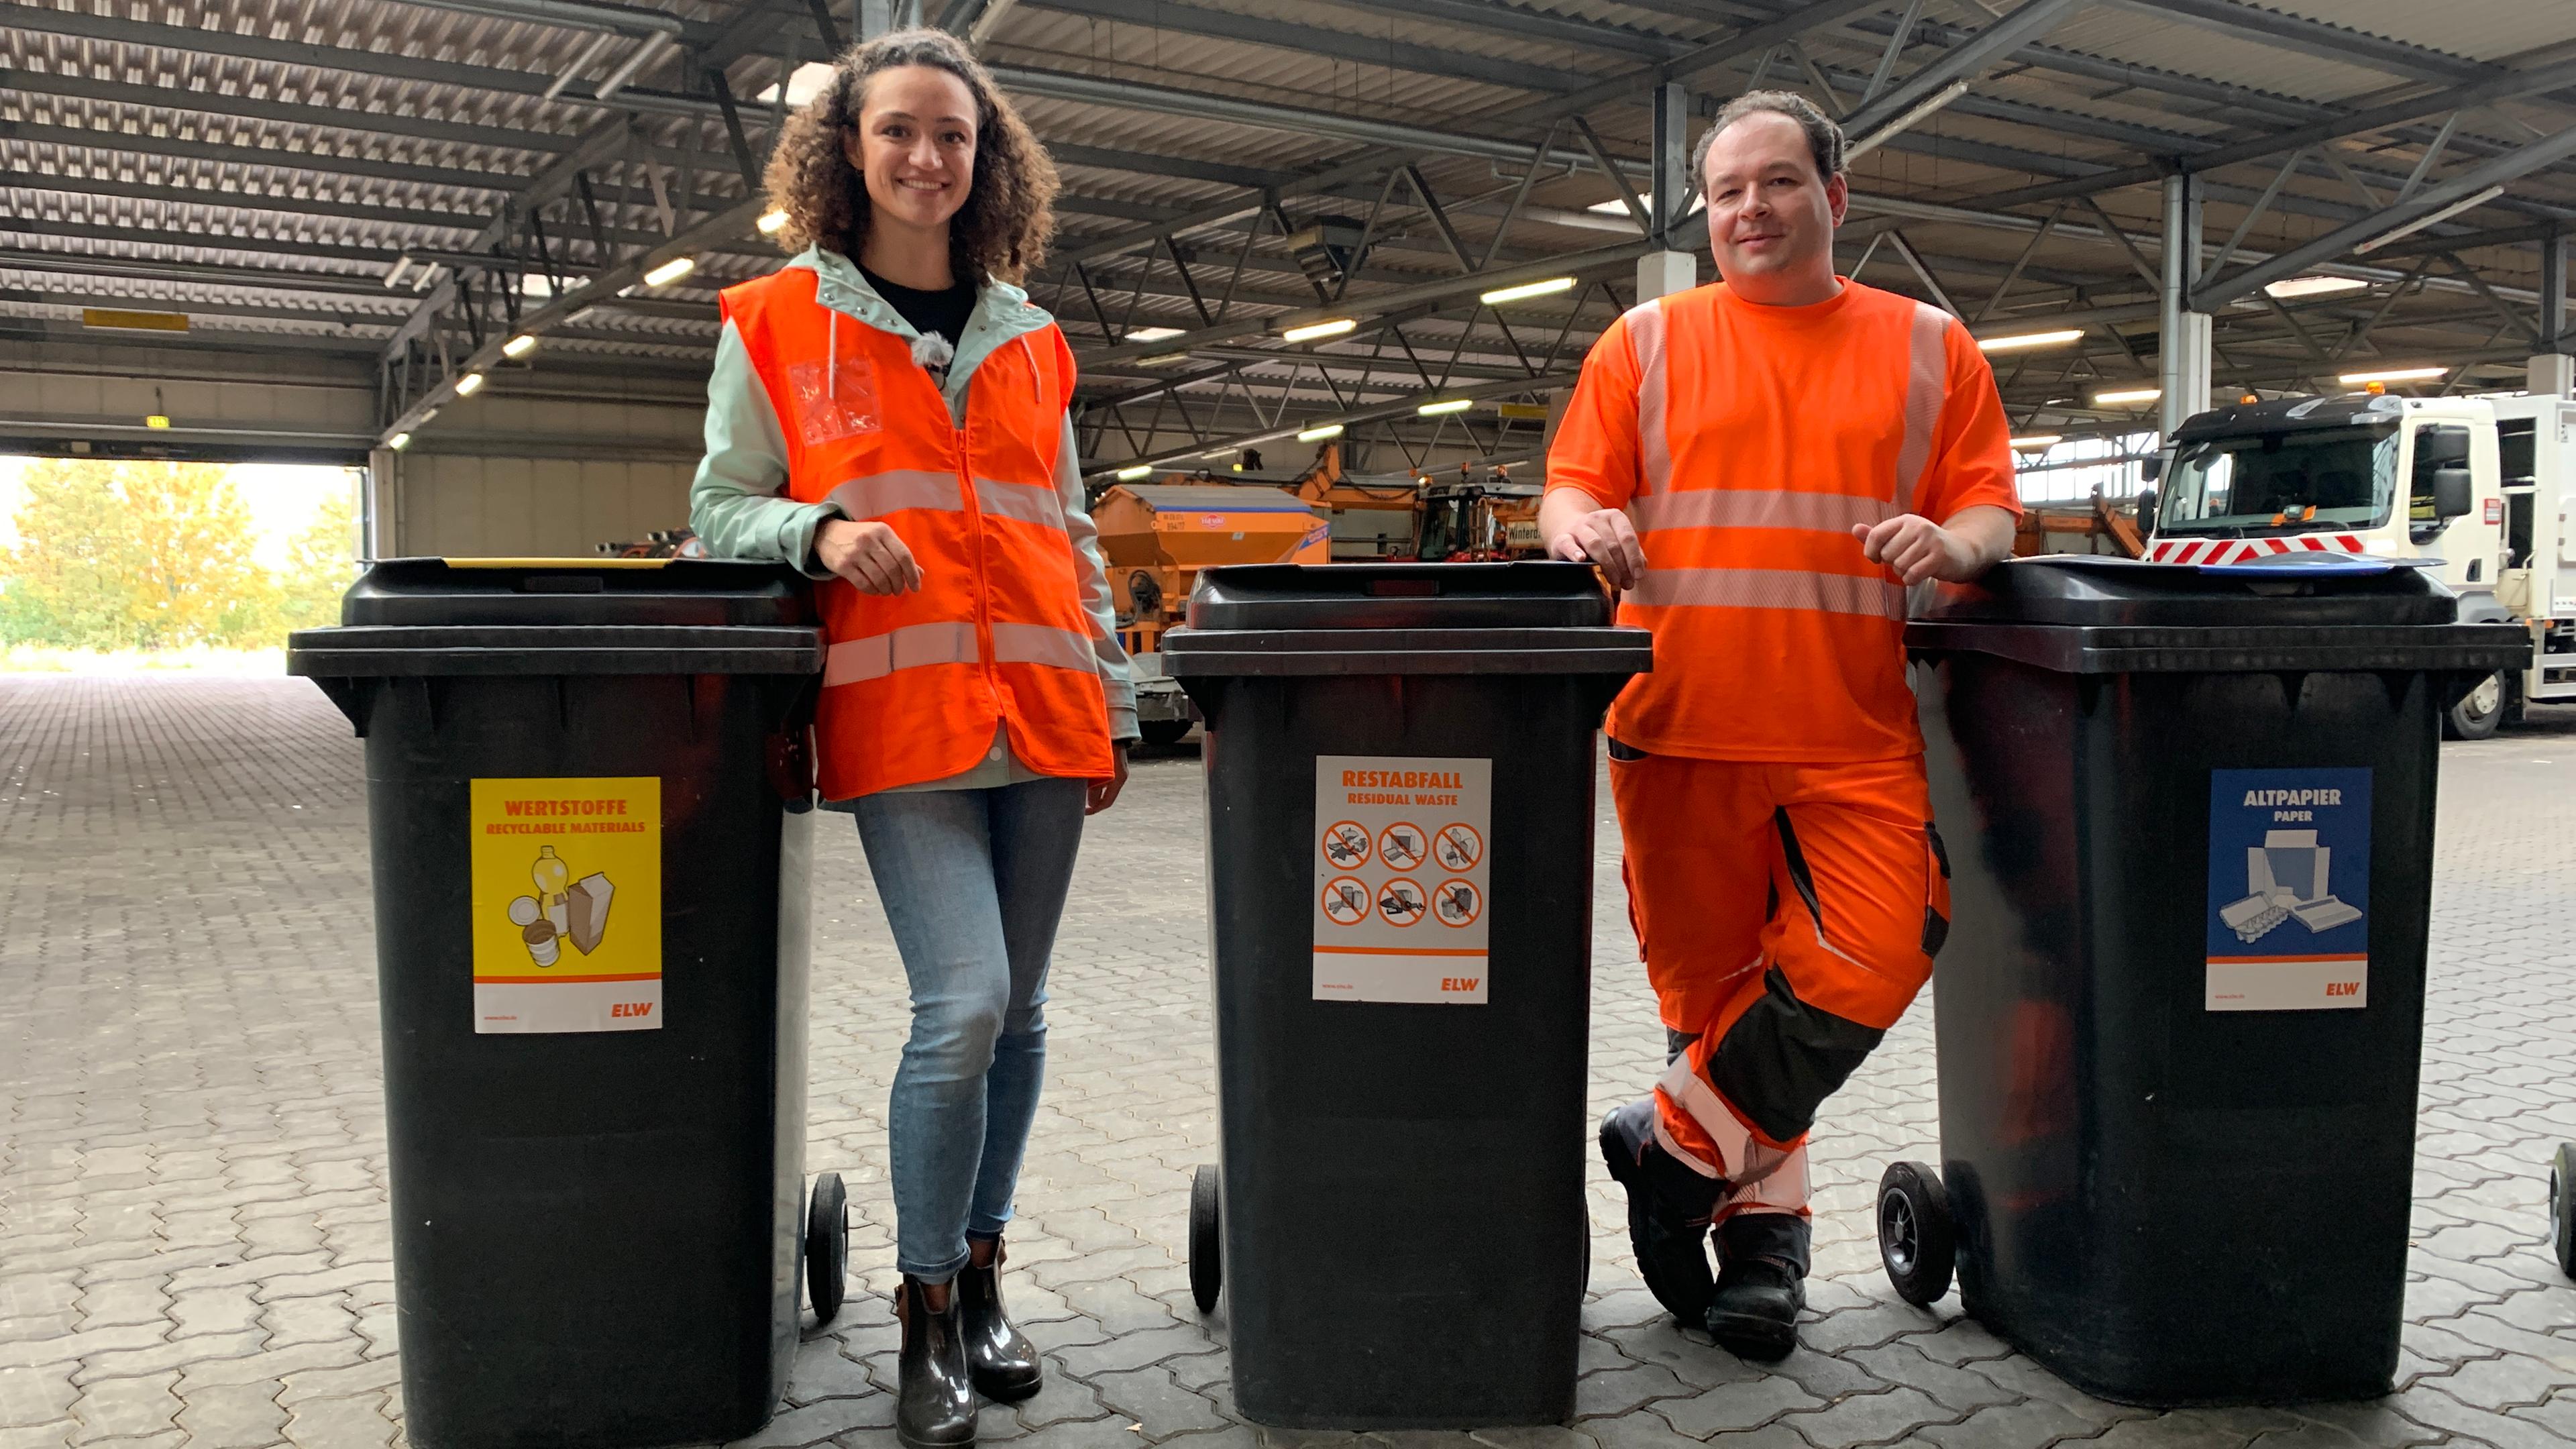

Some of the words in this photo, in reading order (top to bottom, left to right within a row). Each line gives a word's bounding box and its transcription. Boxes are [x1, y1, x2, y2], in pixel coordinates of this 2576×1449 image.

[1342, 770, 1463, 789] RESTABFALL
[1347, 793, 1411, 805] RESIDUAL
[1415, 794, 1458, 805] WASTE
[2243, 789, 2341, 806] ALTPAPIER
[504, 799, 627, 816] WERTSTOFFE
[2273, 810, 2312, 822] PAPER
[486, 822, 566, 835] RECYCLABLE
[570, 822, 645, 833] MATERIALS
[1441, 977, 1479, 991] ELW
[2326, 982, 2360, 996] ELW
[611, 1002, 653, 1018] ELW
